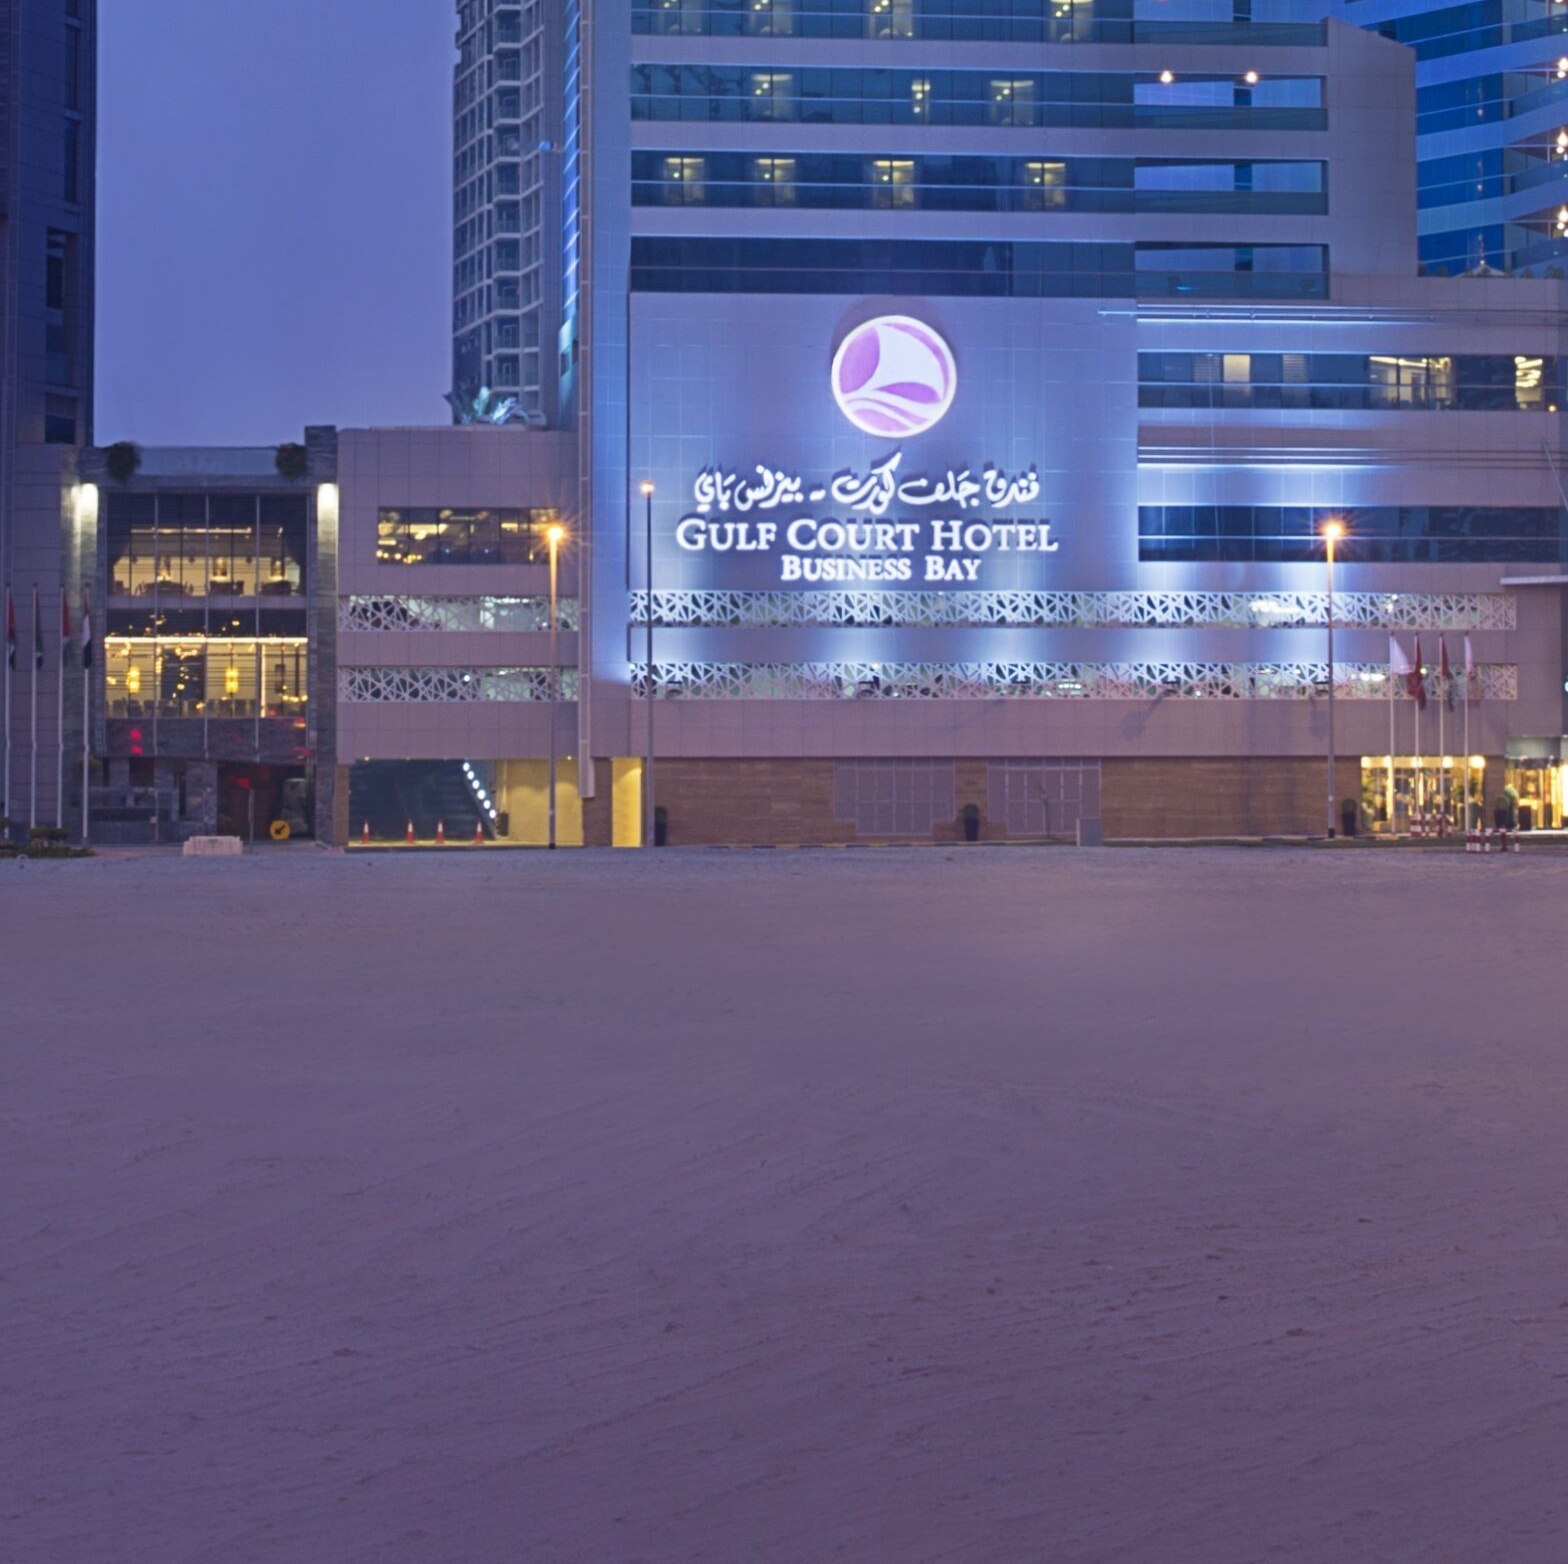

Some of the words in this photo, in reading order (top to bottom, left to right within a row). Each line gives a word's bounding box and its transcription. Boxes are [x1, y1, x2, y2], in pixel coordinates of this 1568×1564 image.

[676, 518, 778, 551] GULF
[787, 518, 921, 552] COURT
[931, 520, 1059, 552] HOTEL
[781, 554, 912, 581] BUSINESS
[924, 555, 982, 581] BAY
